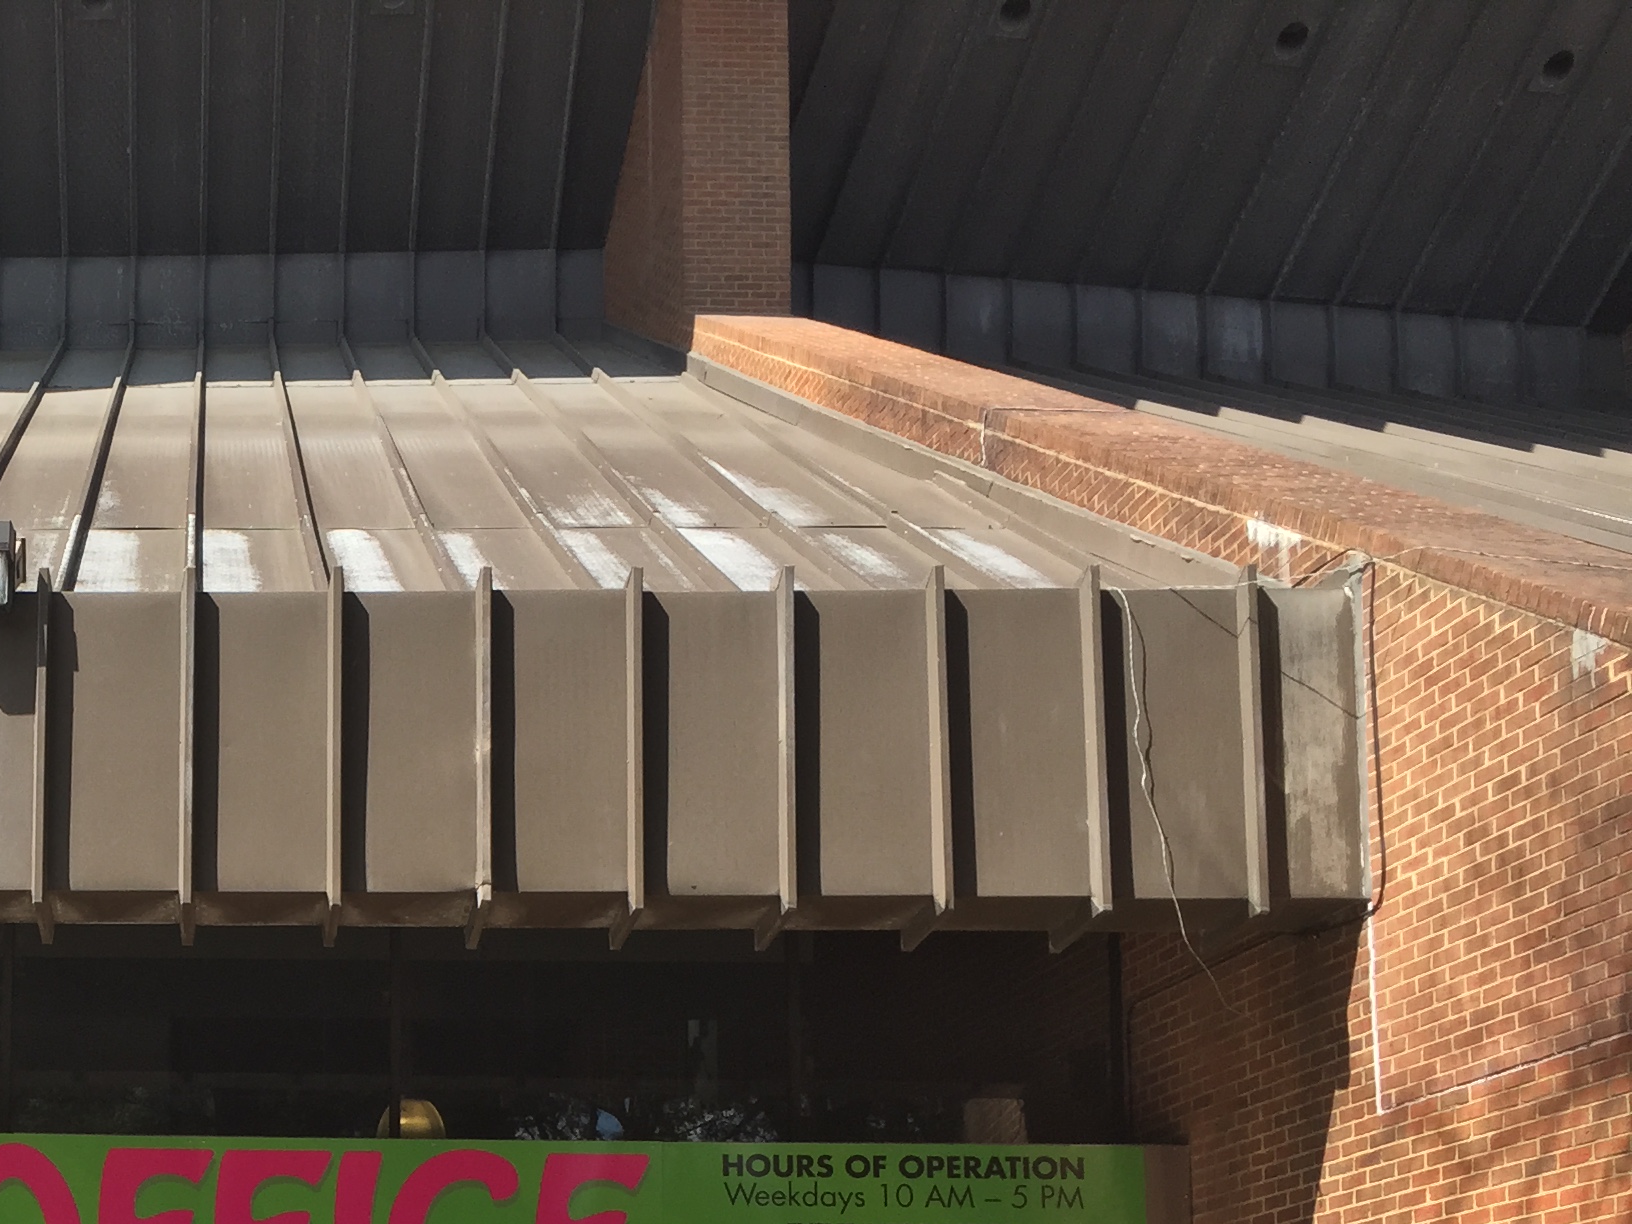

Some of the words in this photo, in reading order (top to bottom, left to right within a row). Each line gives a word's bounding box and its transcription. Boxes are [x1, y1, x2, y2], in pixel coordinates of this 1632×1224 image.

[722, 1154, 834, 1178] HOURS
[845, 1155, 887, 1179] OF
[899, 1155, 1085, 1180] OPERATION
[724, 1181, 866, 1214] Weekdays
[881, 1183, 914, 1208] 10
[925, 1185, 975, 1209] AM
[1011, 1184, 1028, 1209] 5
[1041, 1185, 1084, 1209] PM
